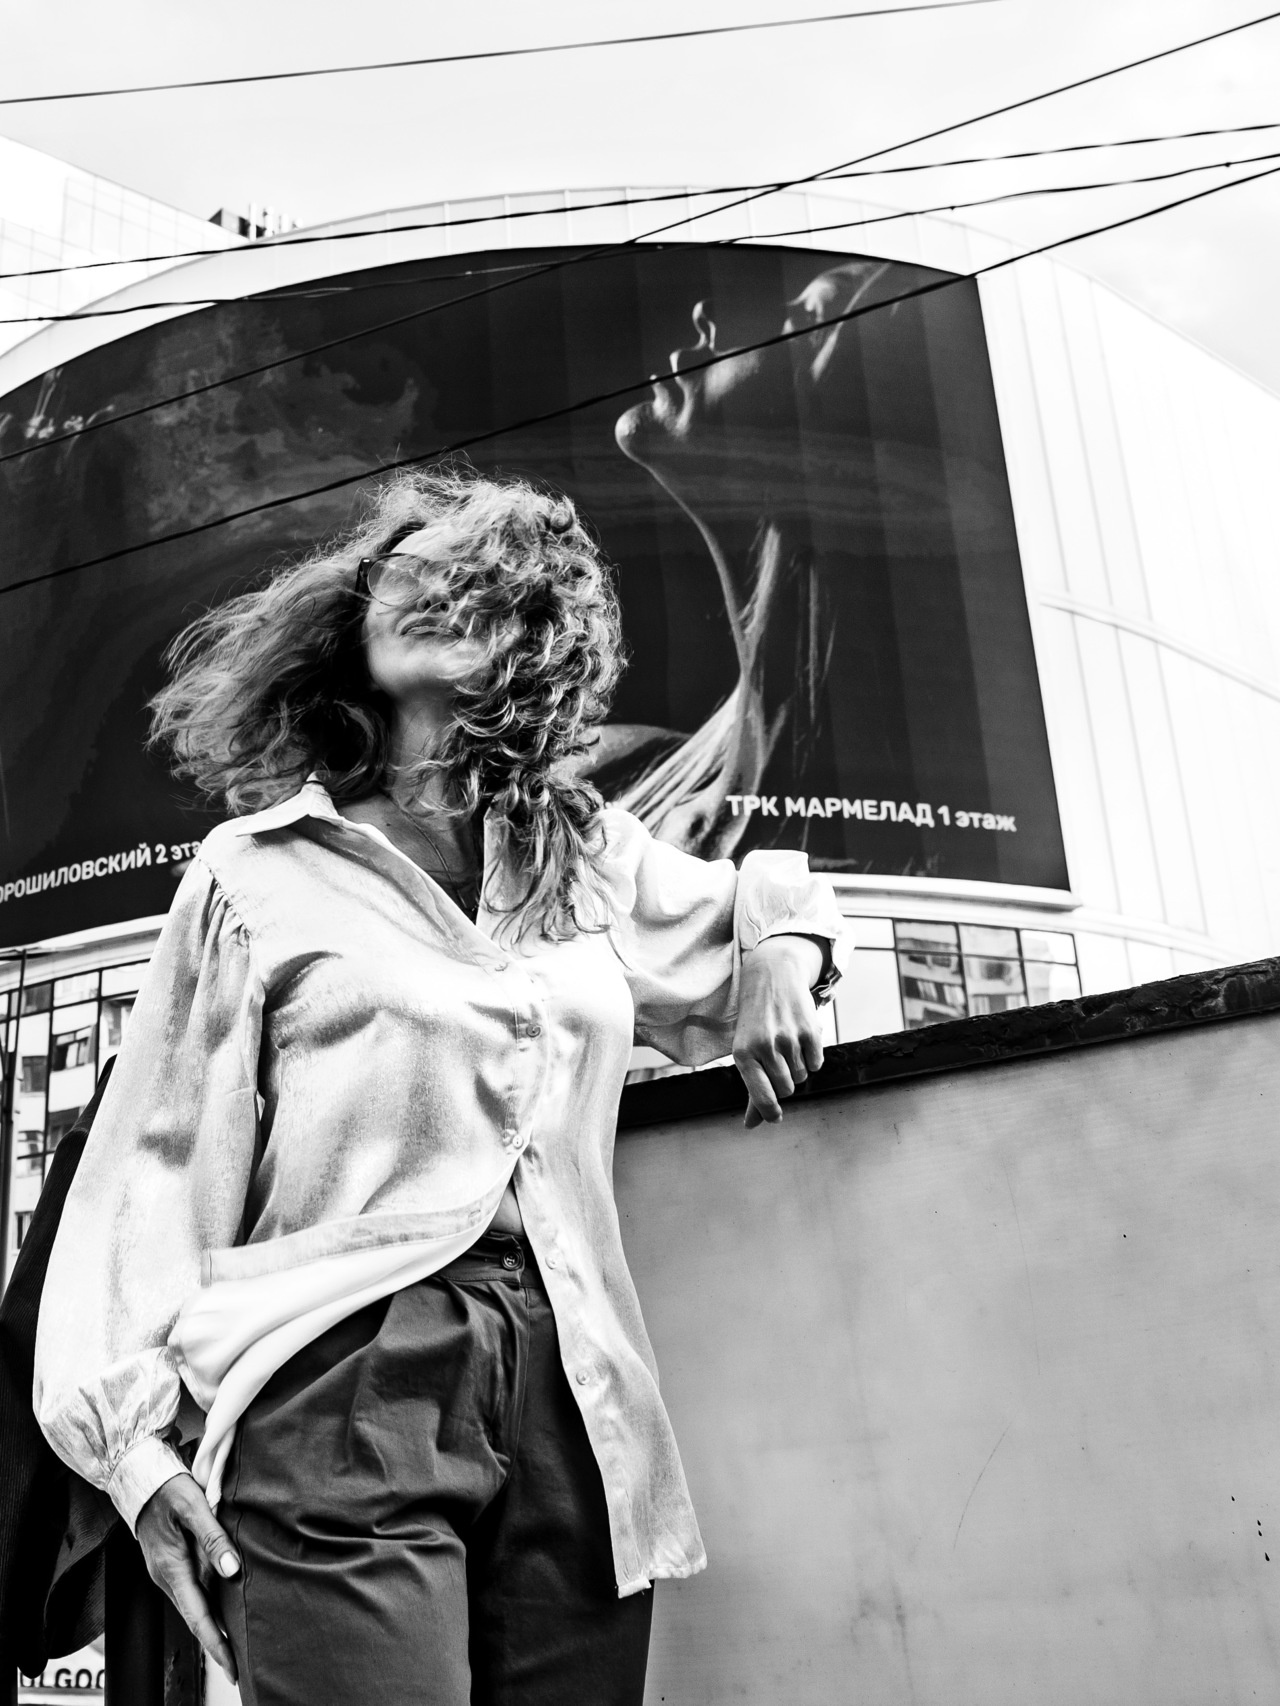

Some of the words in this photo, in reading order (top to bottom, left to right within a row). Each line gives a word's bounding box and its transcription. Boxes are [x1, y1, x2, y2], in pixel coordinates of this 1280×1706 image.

[725, 795, 779, 817] ТРК
[785, 797, 935, 828] МАРМЕЛАД
[937, 805, 950, 826] 1
[955, 810, 1017, 832] этаж
[154, 843, 168, 864] 2
[170, 840, 202, 861] эта
